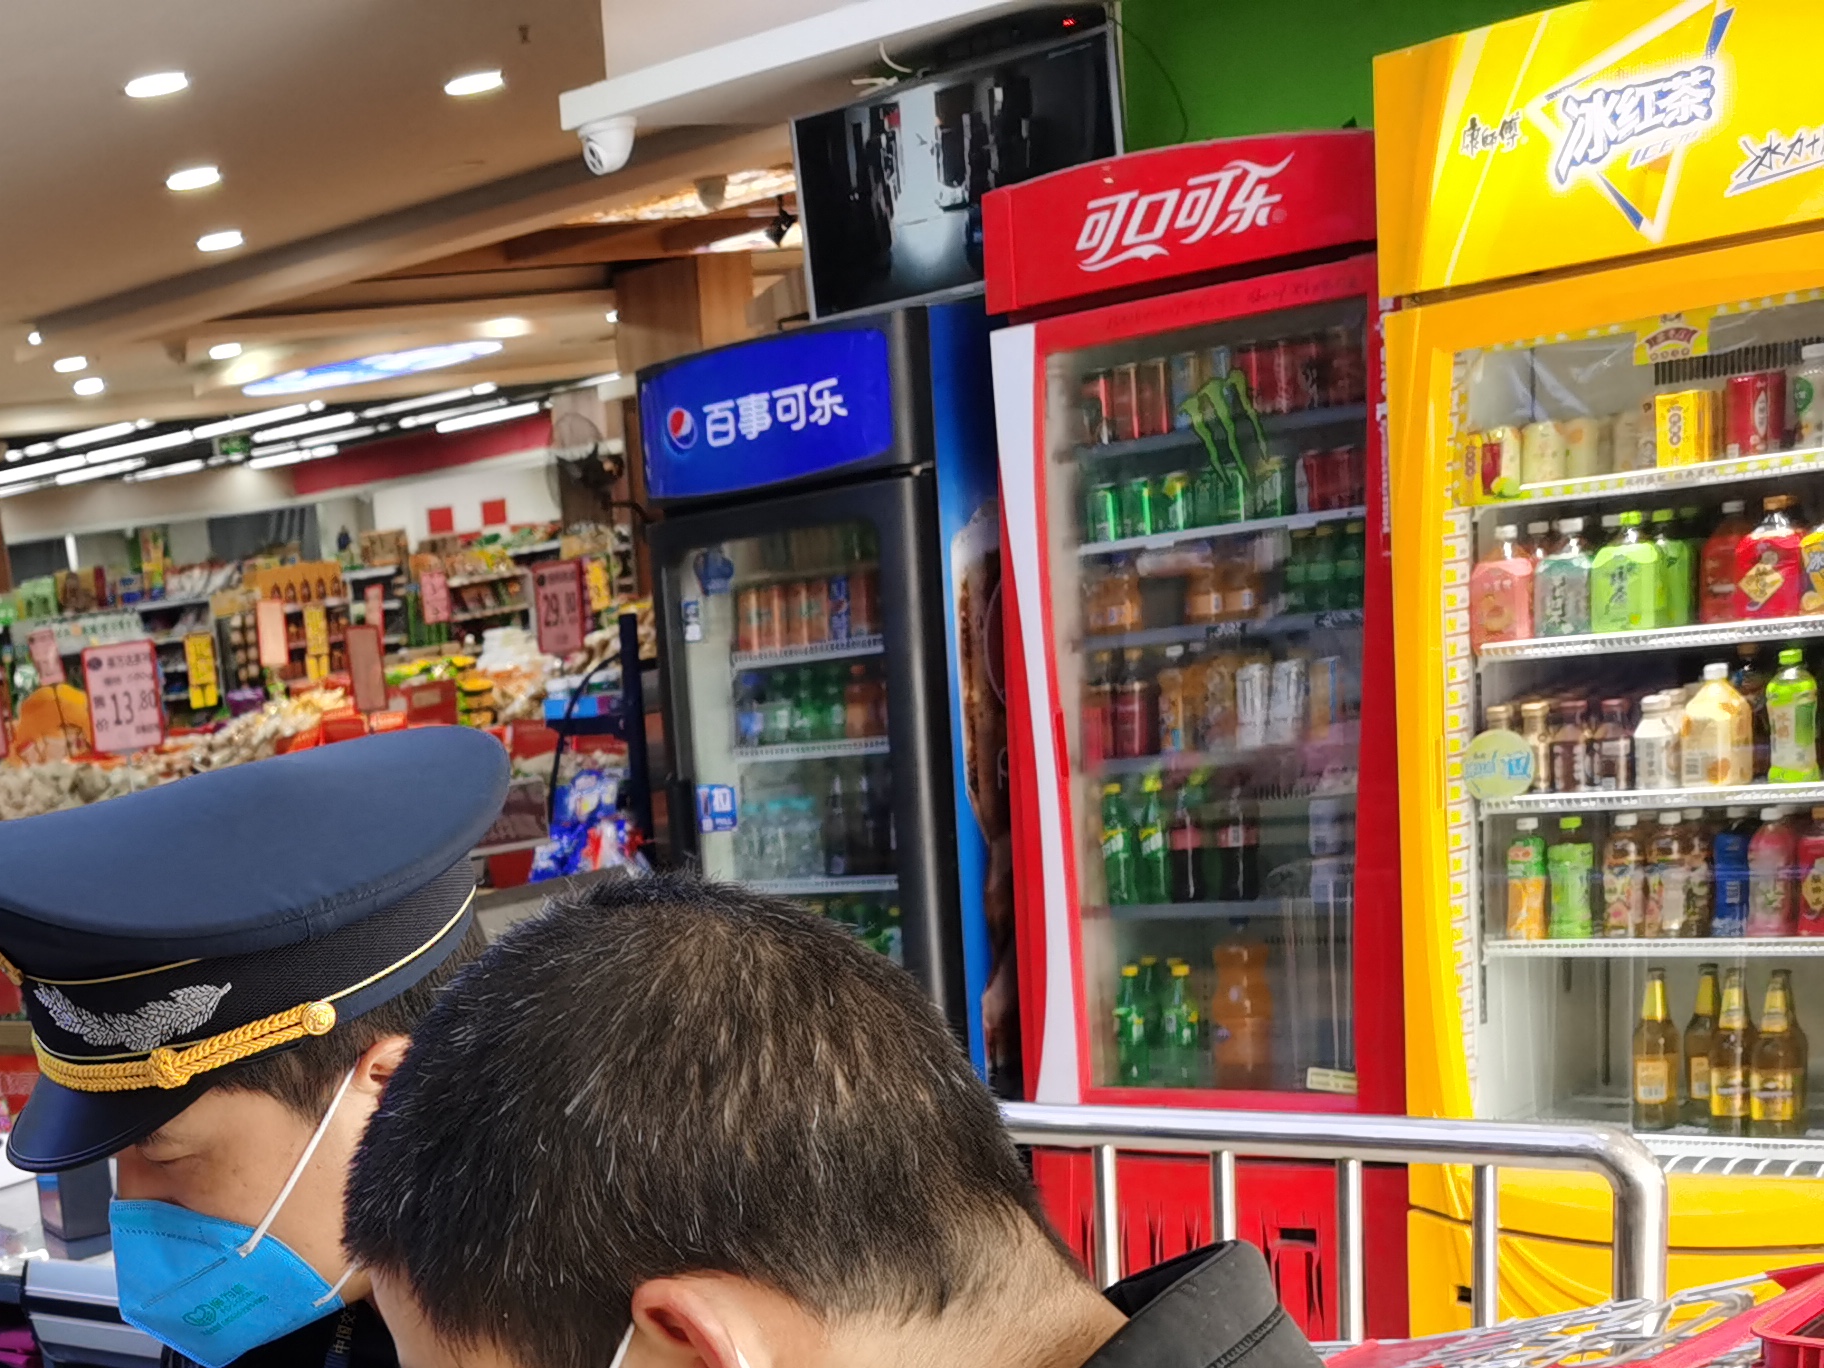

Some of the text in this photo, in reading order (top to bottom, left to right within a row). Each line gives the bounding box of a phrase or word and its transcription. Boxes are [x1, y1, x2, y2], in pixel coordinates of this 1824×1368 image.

[1461, 113, 1523, 158] 康师傅
[1555, 65, 1716, 185] 冰红茶
[1628, 141, 1673, 168] ICE
[1075, 151, 1296, 273] 可口可乐
[702, 376, 849, 448] 百事可乐
